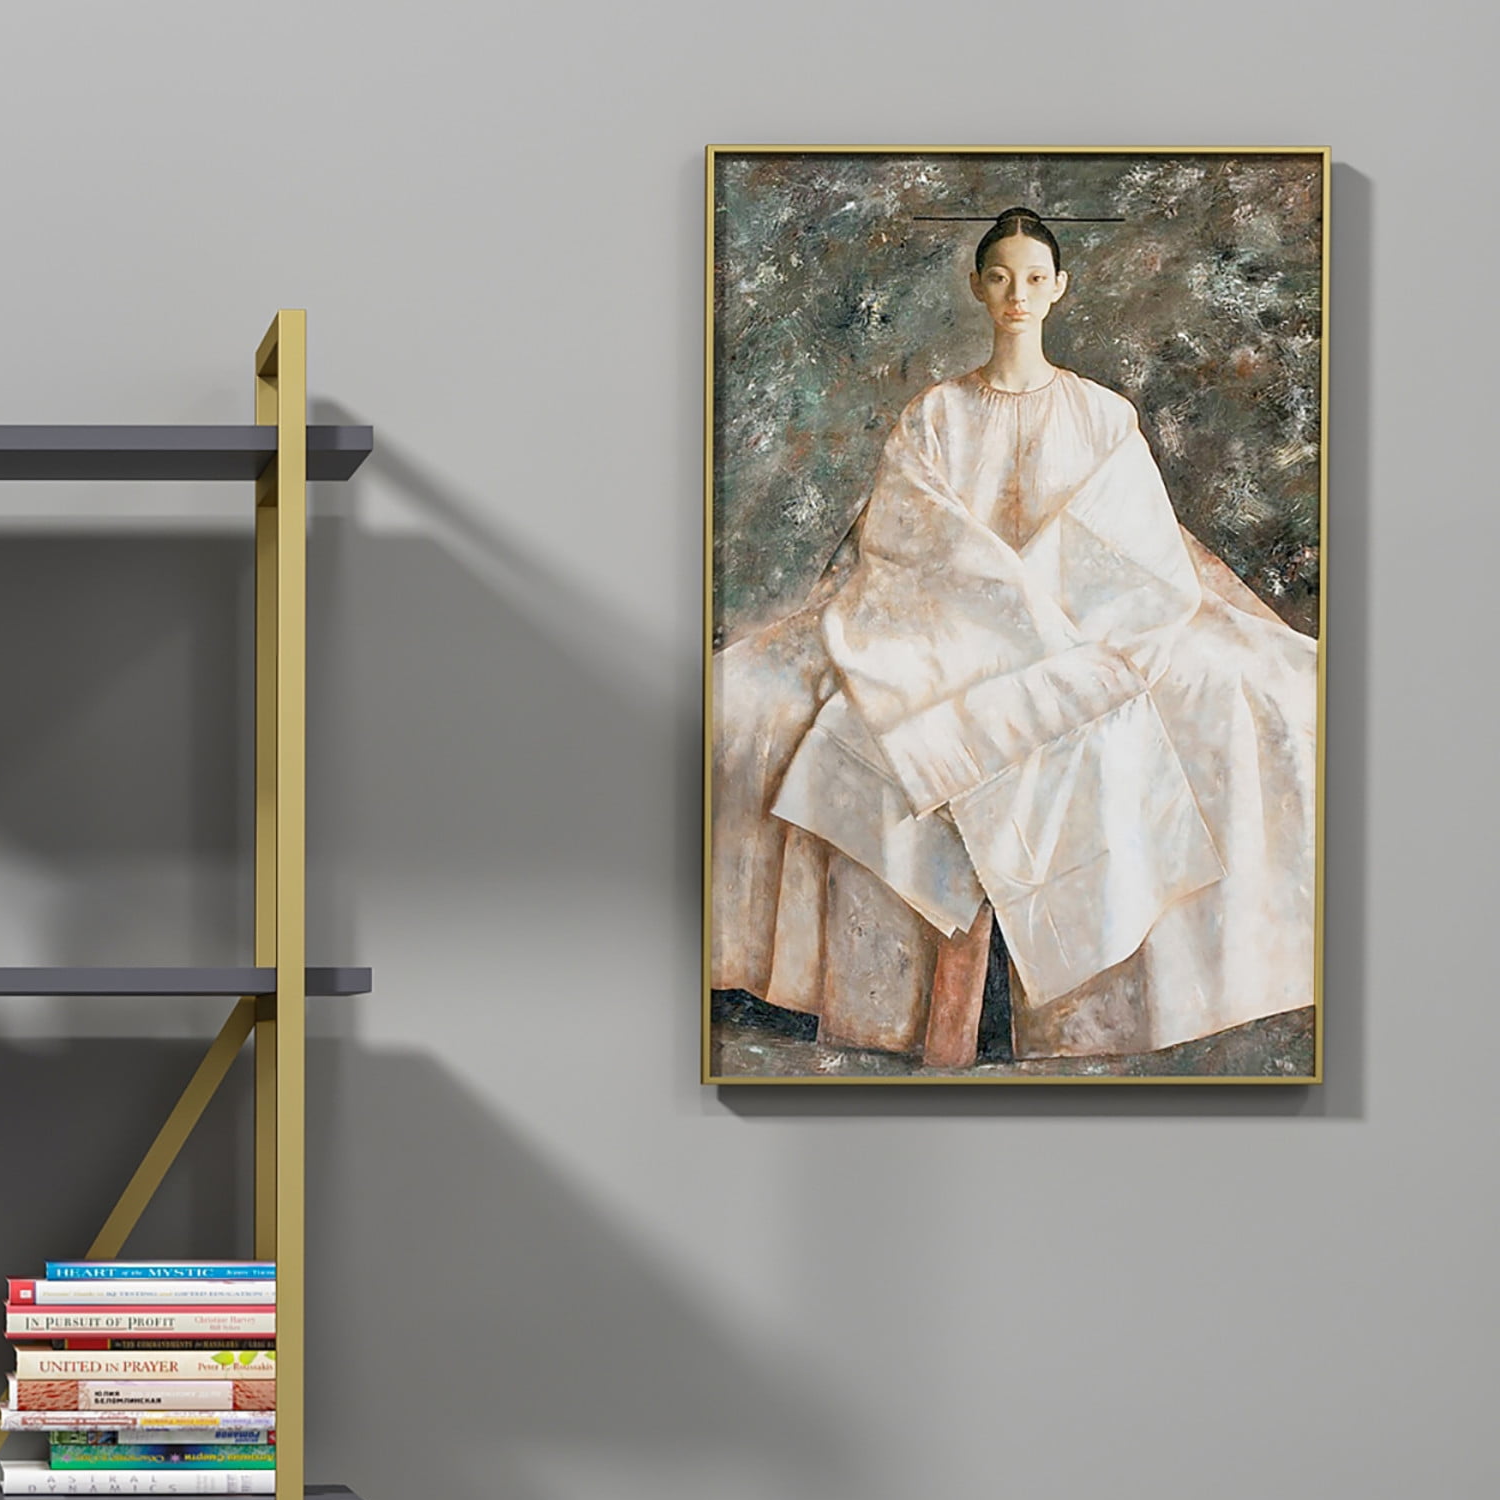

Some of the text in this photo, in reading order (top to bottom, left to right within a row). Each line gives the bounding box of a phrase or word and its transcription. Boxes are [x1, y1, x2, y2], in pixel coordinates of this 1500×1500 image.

[56, 1268, 116, 1277] HEART
[130, 1269, 143, 1277] the
[148, 1268, 214, 1277] MYSTIC
[25, 1316, 175, 1331] IN PURSUIT OF PROFIT
[194, 1316, 256, 1326] Christine Harvey
[39, 1361, 179, 1373] UNITED IN PRAYER
[197, 1362, 218, 1372] Peter
[47, 1475, 157, 1483] ASTRAL
[27, 1484, 178, 1492] DYNAMICS
